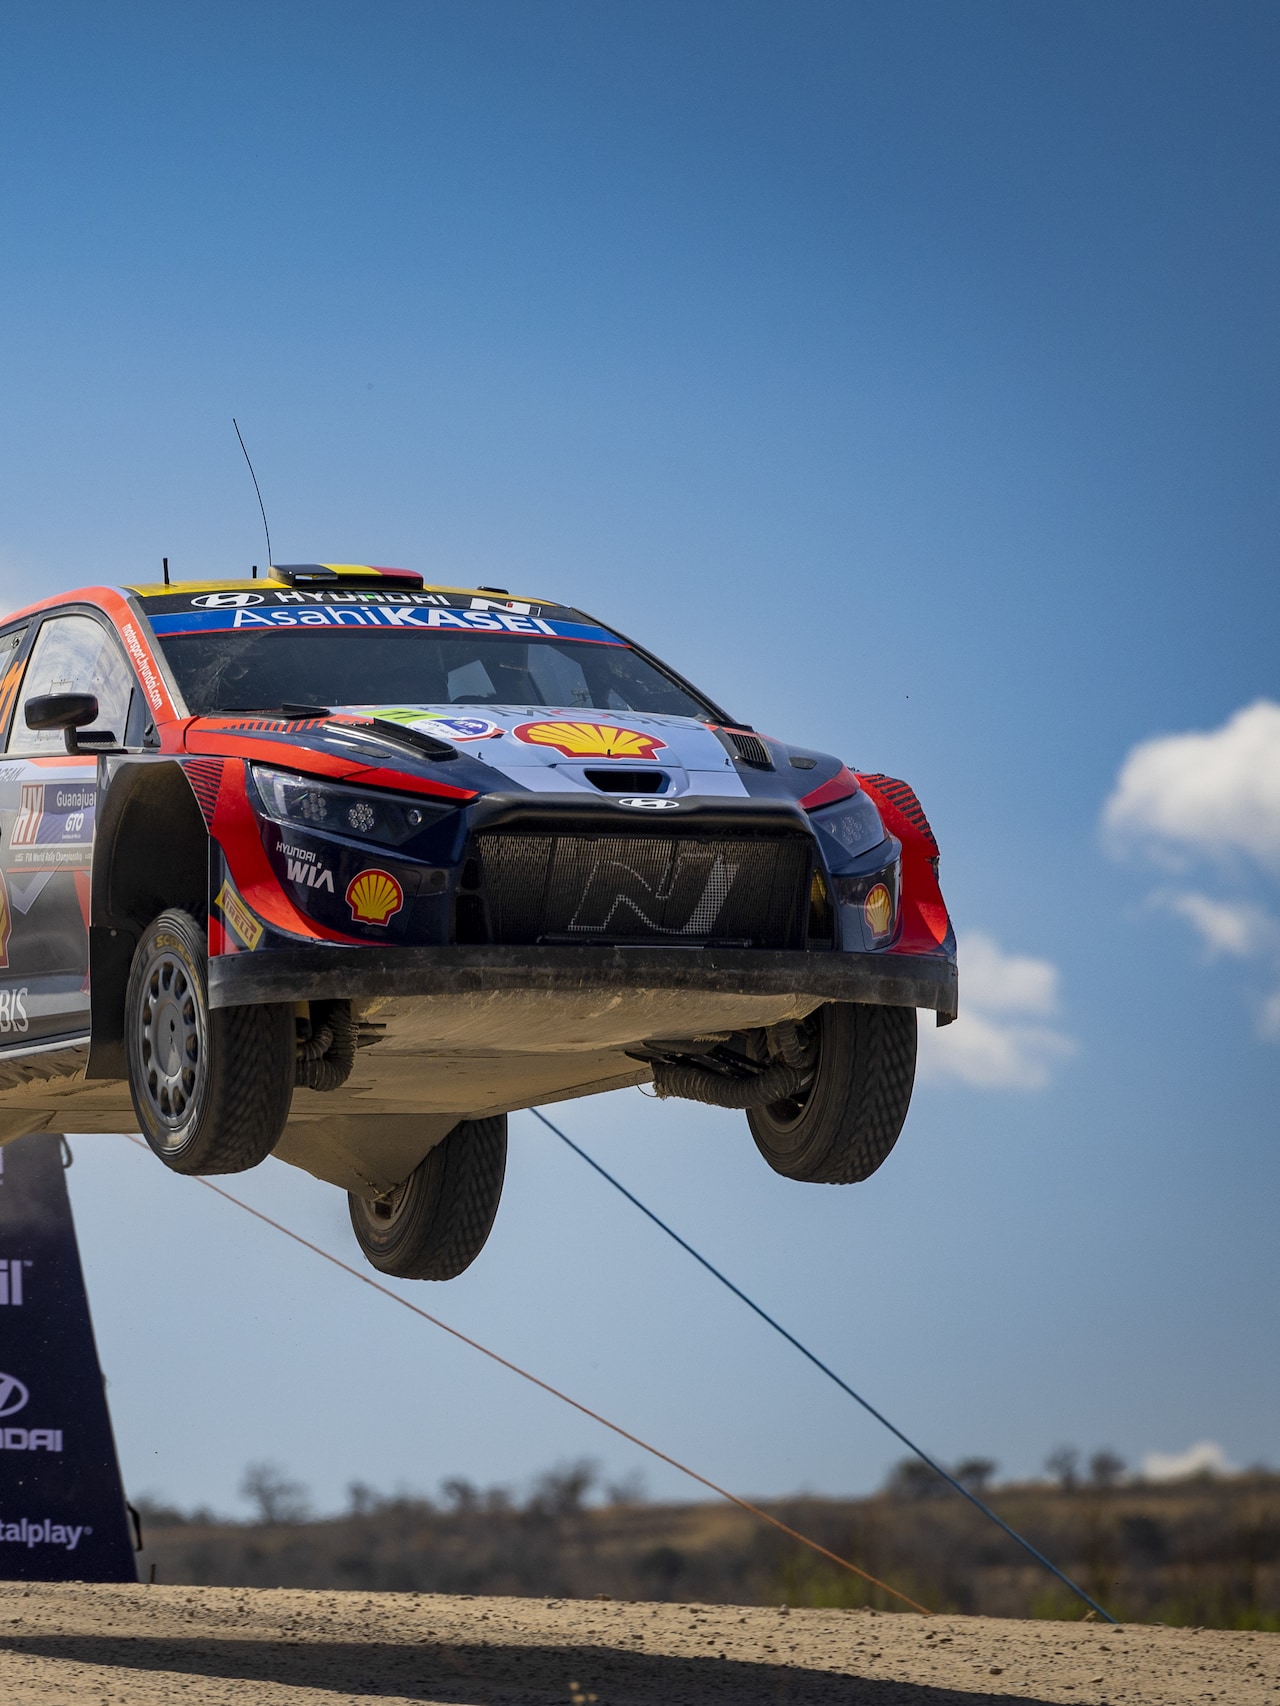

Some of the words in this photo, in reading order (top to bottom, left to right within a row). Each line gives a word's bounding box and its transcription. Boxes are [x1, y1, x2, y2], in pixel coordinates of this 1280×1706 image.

[274, 591, 451, 606] HYUNDAI
[122, 623, 163, 710] motorsport.hyundai.com
[65, 812, 84, 832] GTO
[276, 841, 316, 863] HYUNDAI
[286, 858, 335, 894] WIA
[221, 888, 258, 943] PIRELLI
